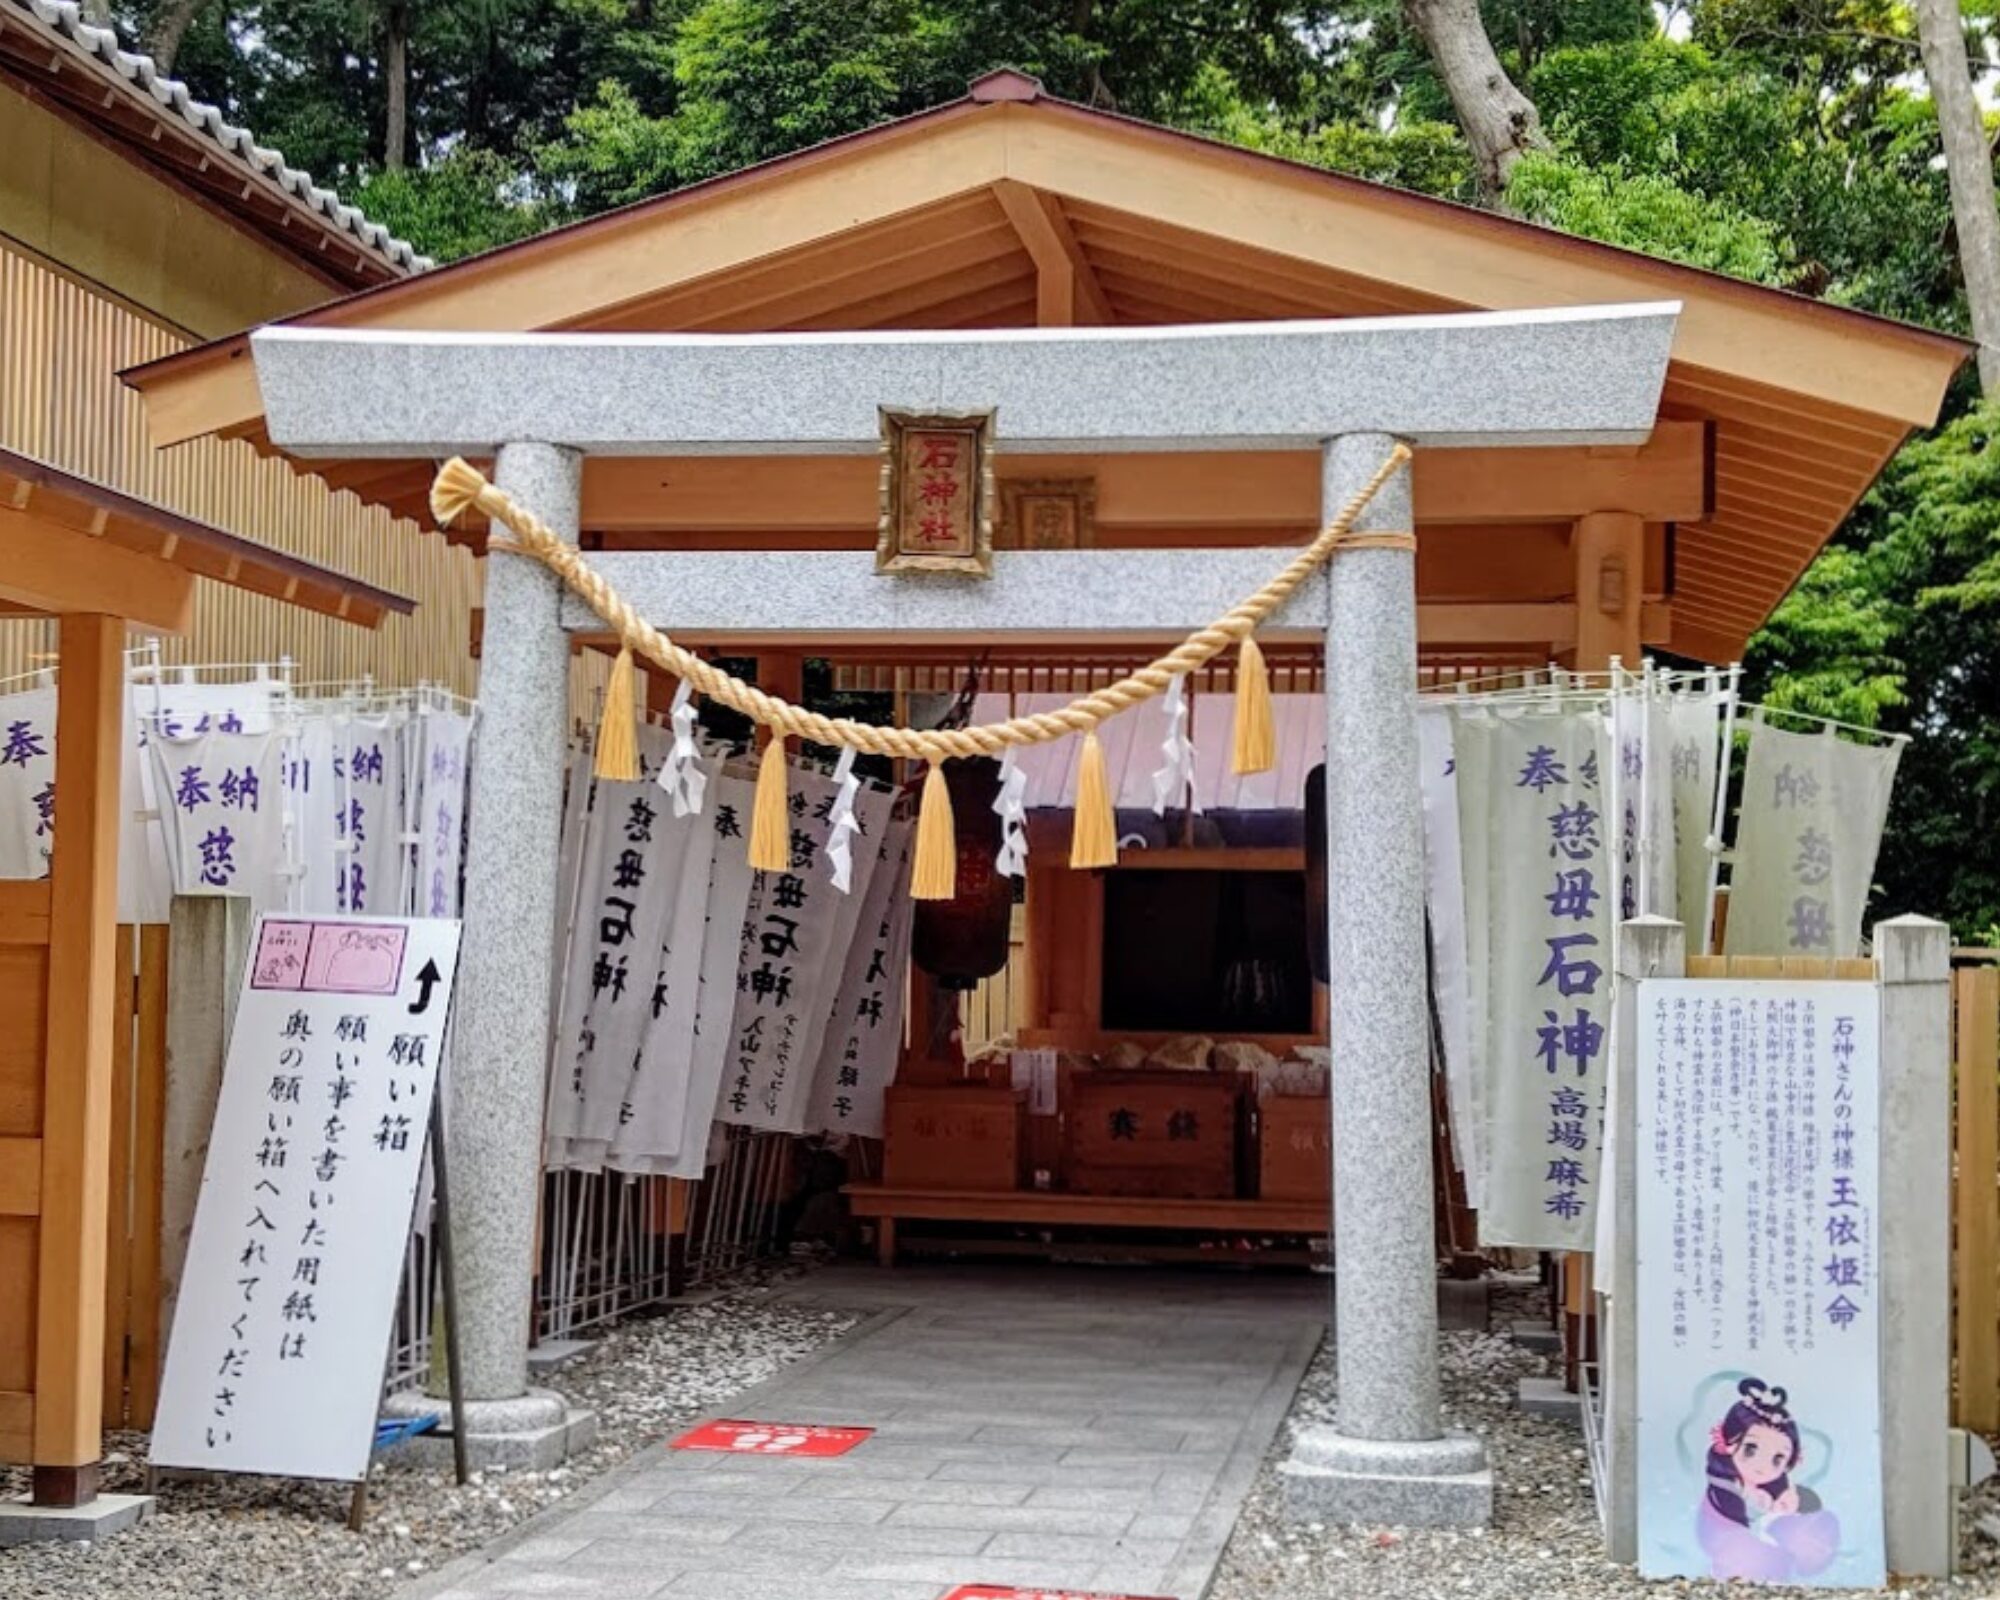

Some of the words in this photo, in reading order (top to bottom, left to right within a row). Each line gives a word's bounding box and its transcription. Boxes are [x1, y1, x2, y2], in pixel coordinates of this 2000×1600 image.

[915, 438, 960, 544] 石神社
[177, 765, 260, 815] 奉納
[1535, 801, 1606, 1078] 慈母石神
[373, 1033, 429, 1151] 願い箱
[1544, 1086, 1590, 1221] 高場麻希
[1831, 1015, 1856, 1169] 石神さんの神様
[206, 1008, 313, 1448] 奥の願い箱へ入れてください
[279, 1014, 369, 1361] 願い事を書いた用紙は
[1822, 1176, 1863, 1332] 玉依姫命
